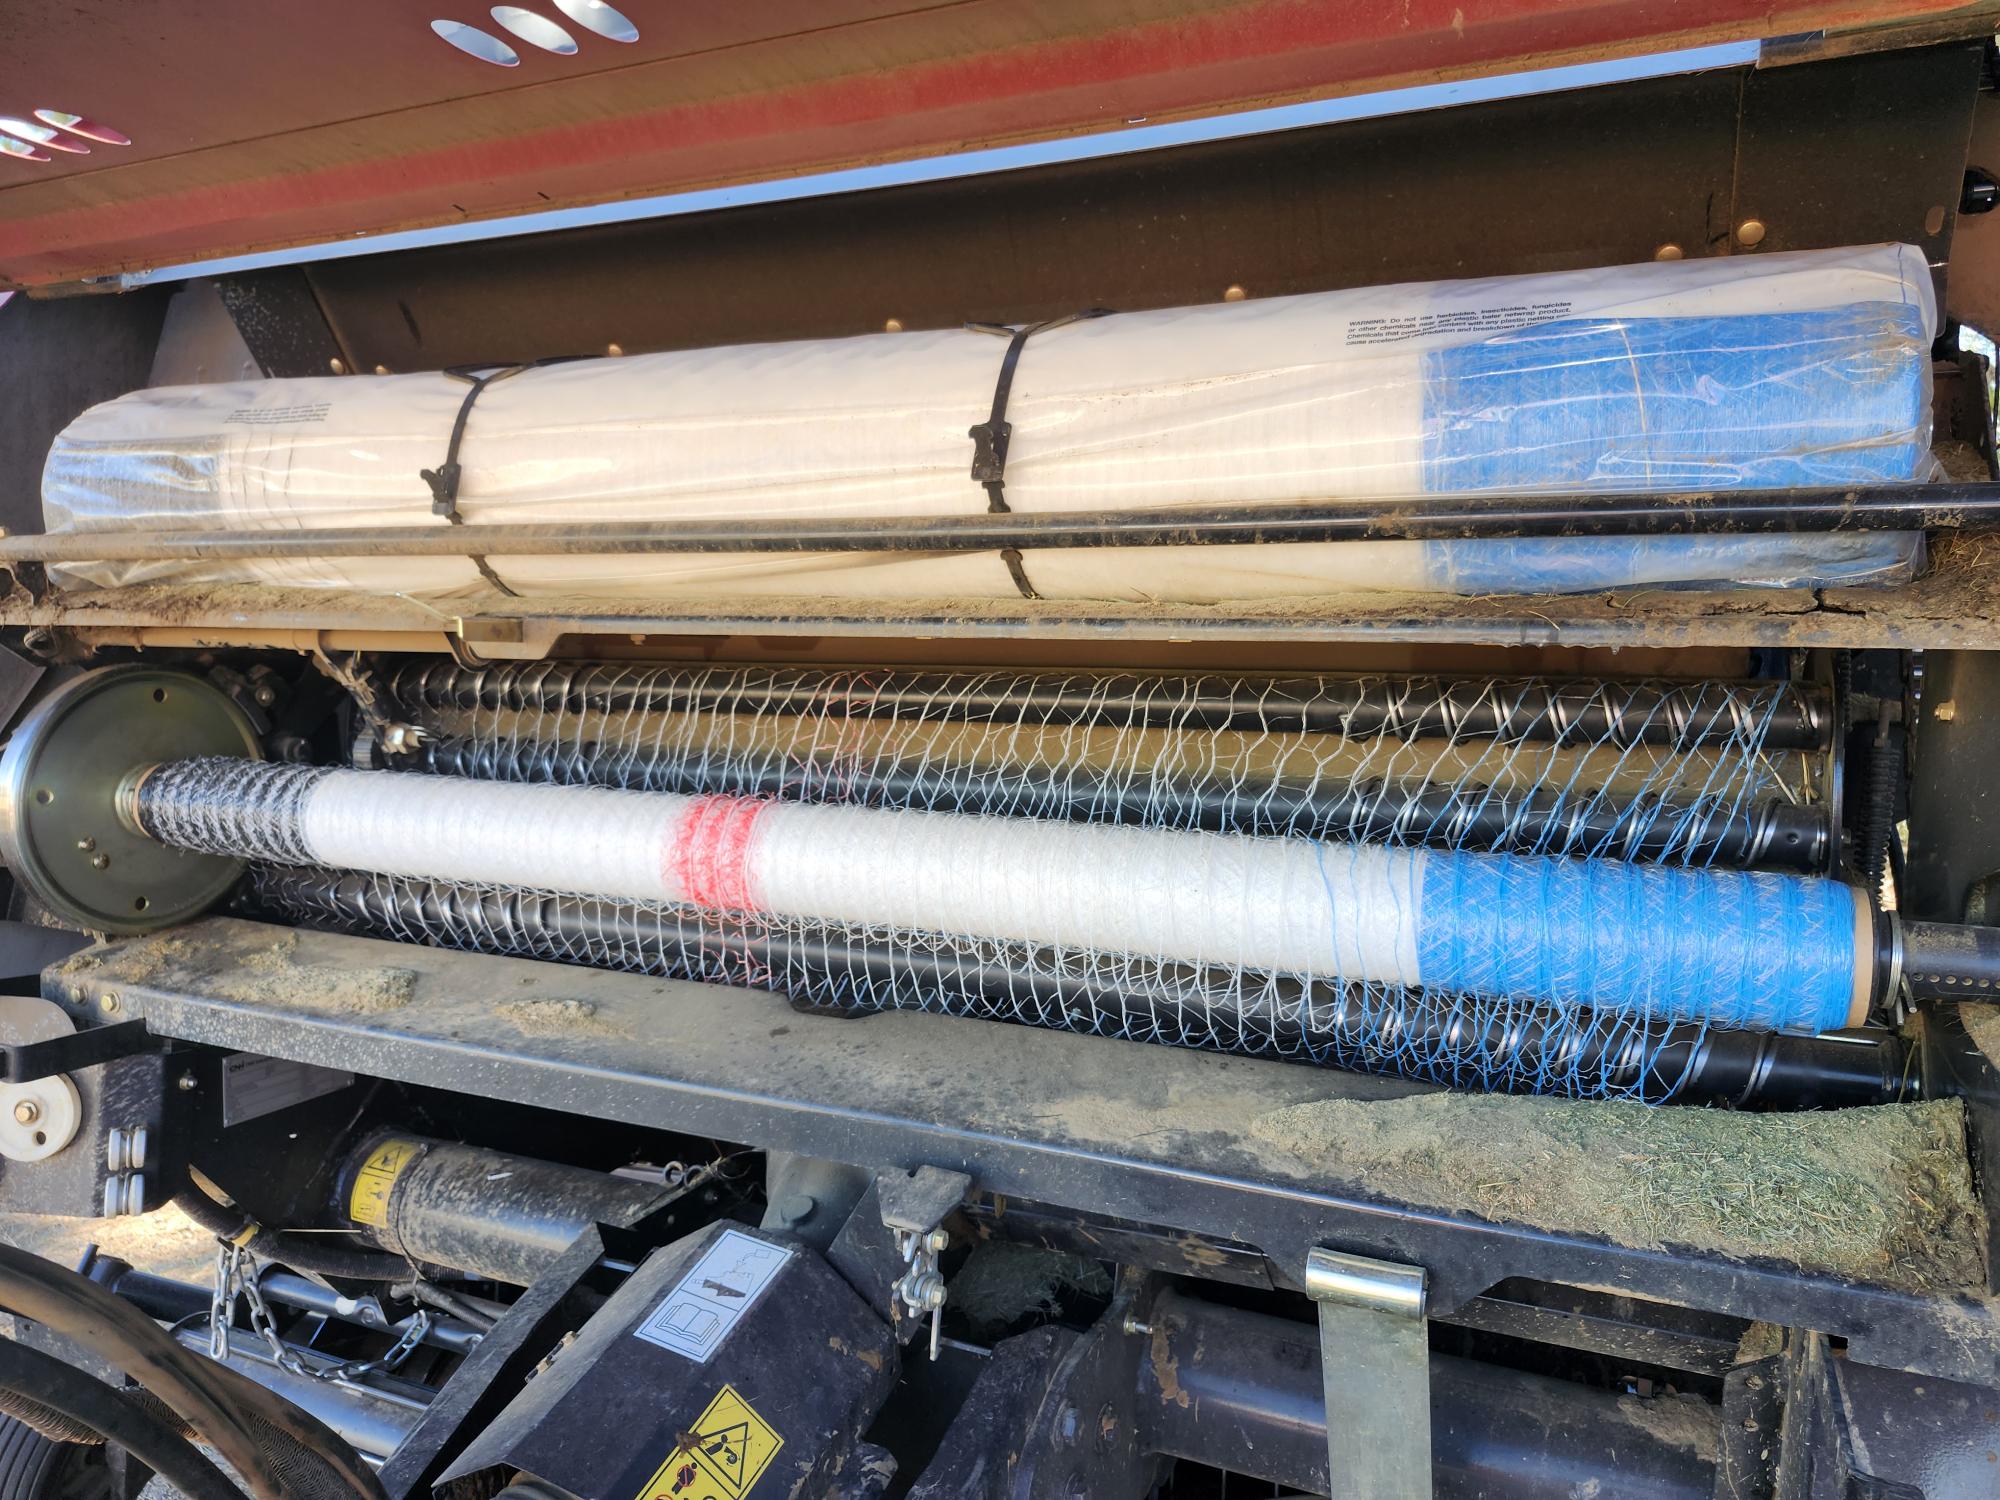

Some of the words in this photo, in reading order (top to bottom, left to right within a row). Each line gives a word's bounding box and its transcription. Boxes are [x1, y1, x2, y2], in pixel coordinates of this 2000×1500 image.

[1481, 306, 1528, 314] insecticides,
[1532, 302, 1572, 310] fungicides
[1539, 308, 1571, 316] product.
[1472, 324, 1515, 332] breakdown
